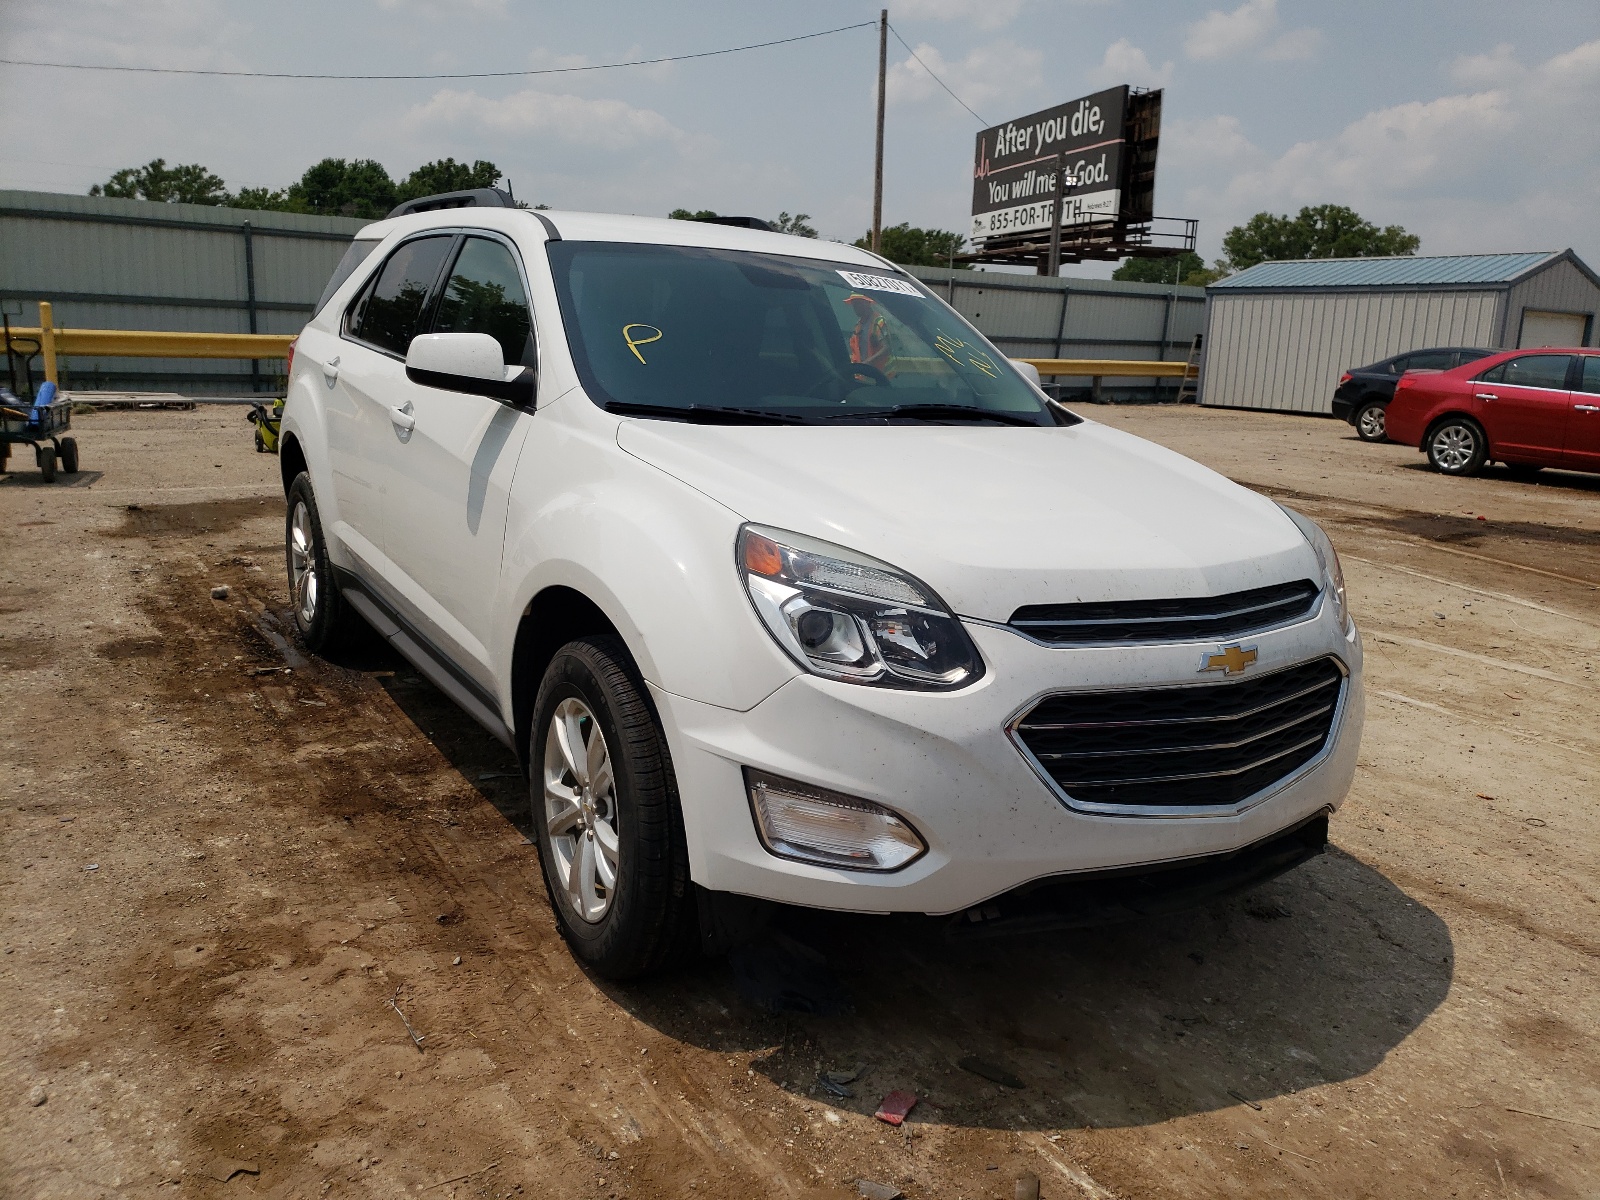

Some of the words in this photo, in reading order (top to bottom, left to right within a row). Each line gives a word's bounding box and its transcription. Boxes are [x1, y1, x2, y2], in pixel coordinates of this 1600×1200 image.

[995, 123, 1033, 158] After
[1035, 116, 1068, 155] you
[1071, 100, 1105, 137] die,
[989, 181, 1010, 204] You
[1012, 170, 1036, 199] will
[1036, 165, 1072, 194] me
[1074, 153, 1109, 187] God.
[989, 199, 1082, 231] 855-FOR-TRTH
[622, 323, 663, 365] P
